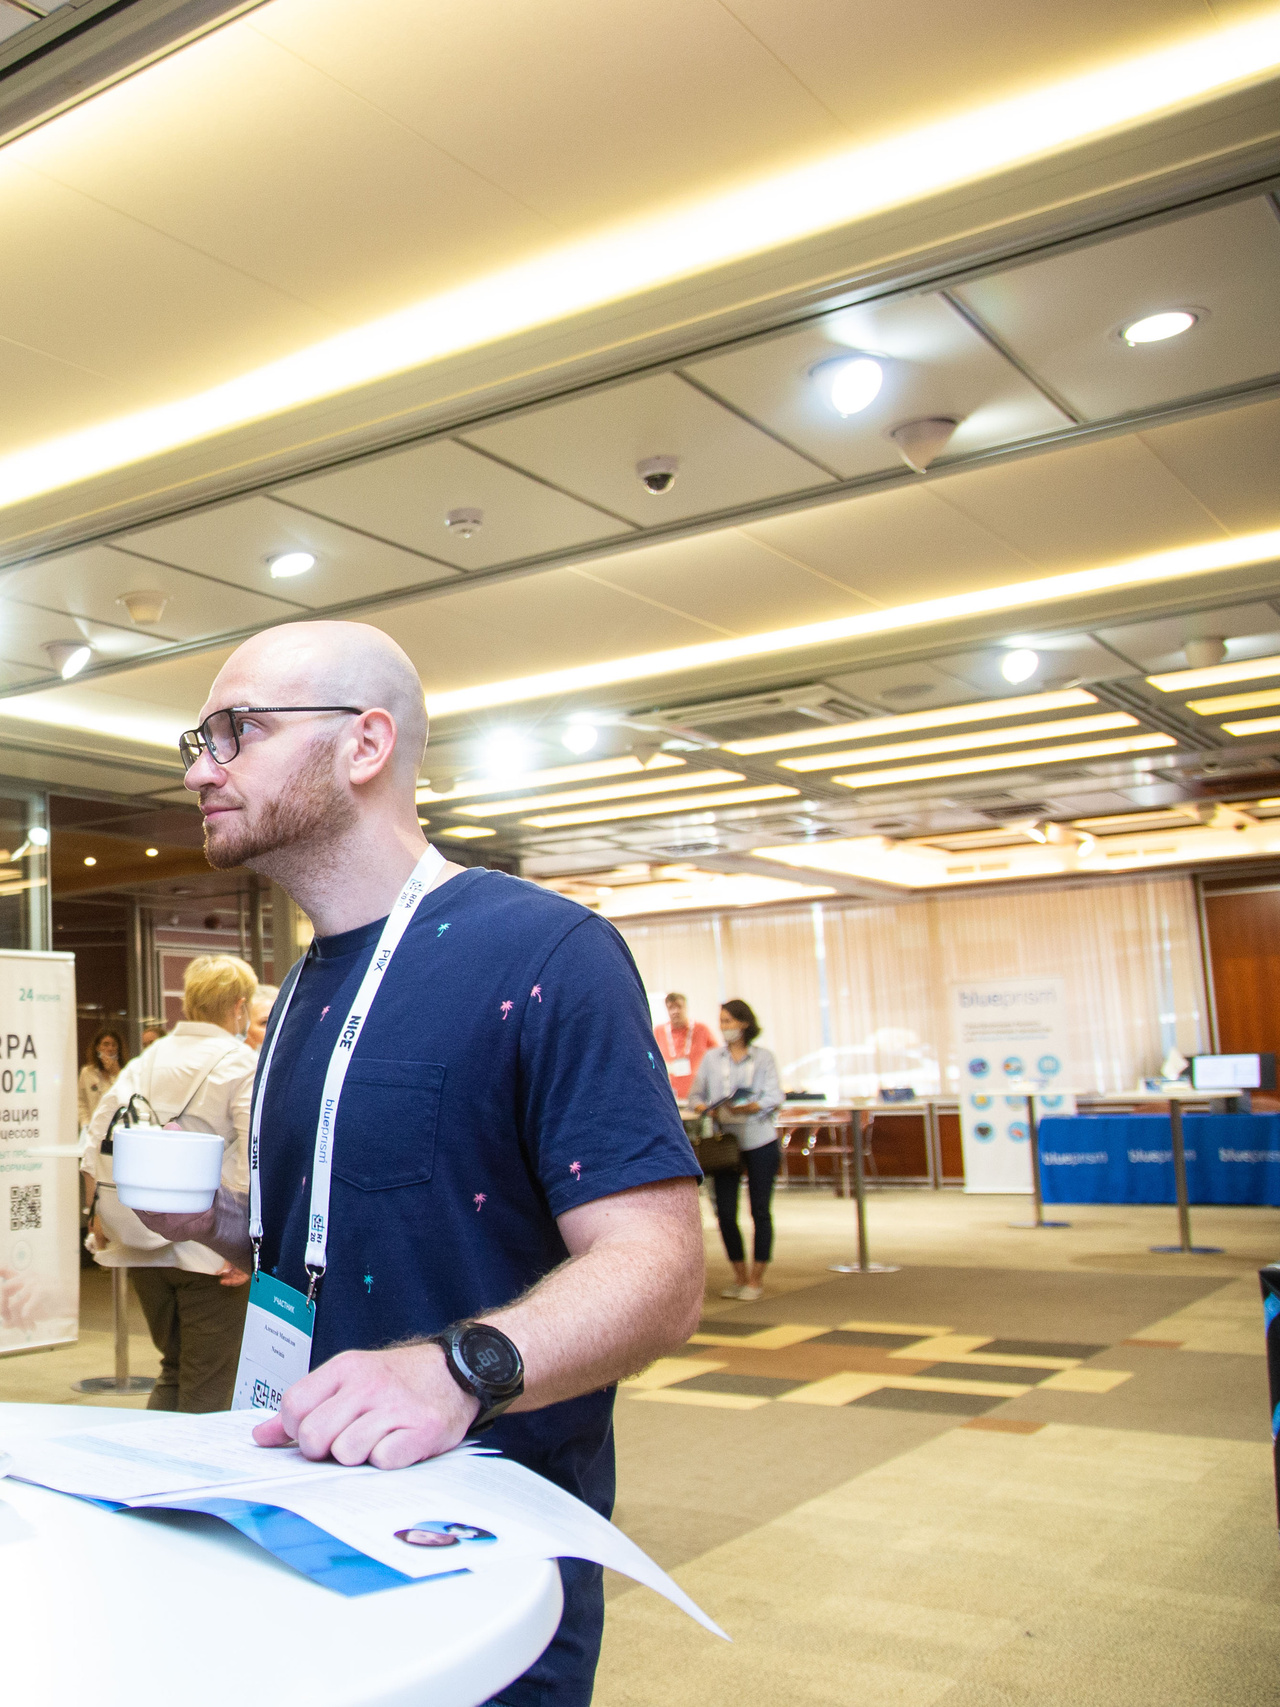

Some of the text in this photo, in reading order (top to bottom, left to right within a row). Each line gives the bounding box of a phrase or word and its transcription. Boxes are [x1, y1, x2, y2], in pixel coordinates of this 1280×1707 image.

[404, 893, 418, 909] RPA
[374, 949, 391, 971] PIX
[19, 988, 34, 1002] 24
[339, 1014, 362, 1051] NICE
[318, 1099, 335, 1164] blueprism
[251, 1134, 259, 1170] NICE
[271, 1388, 282, 1404] RP
